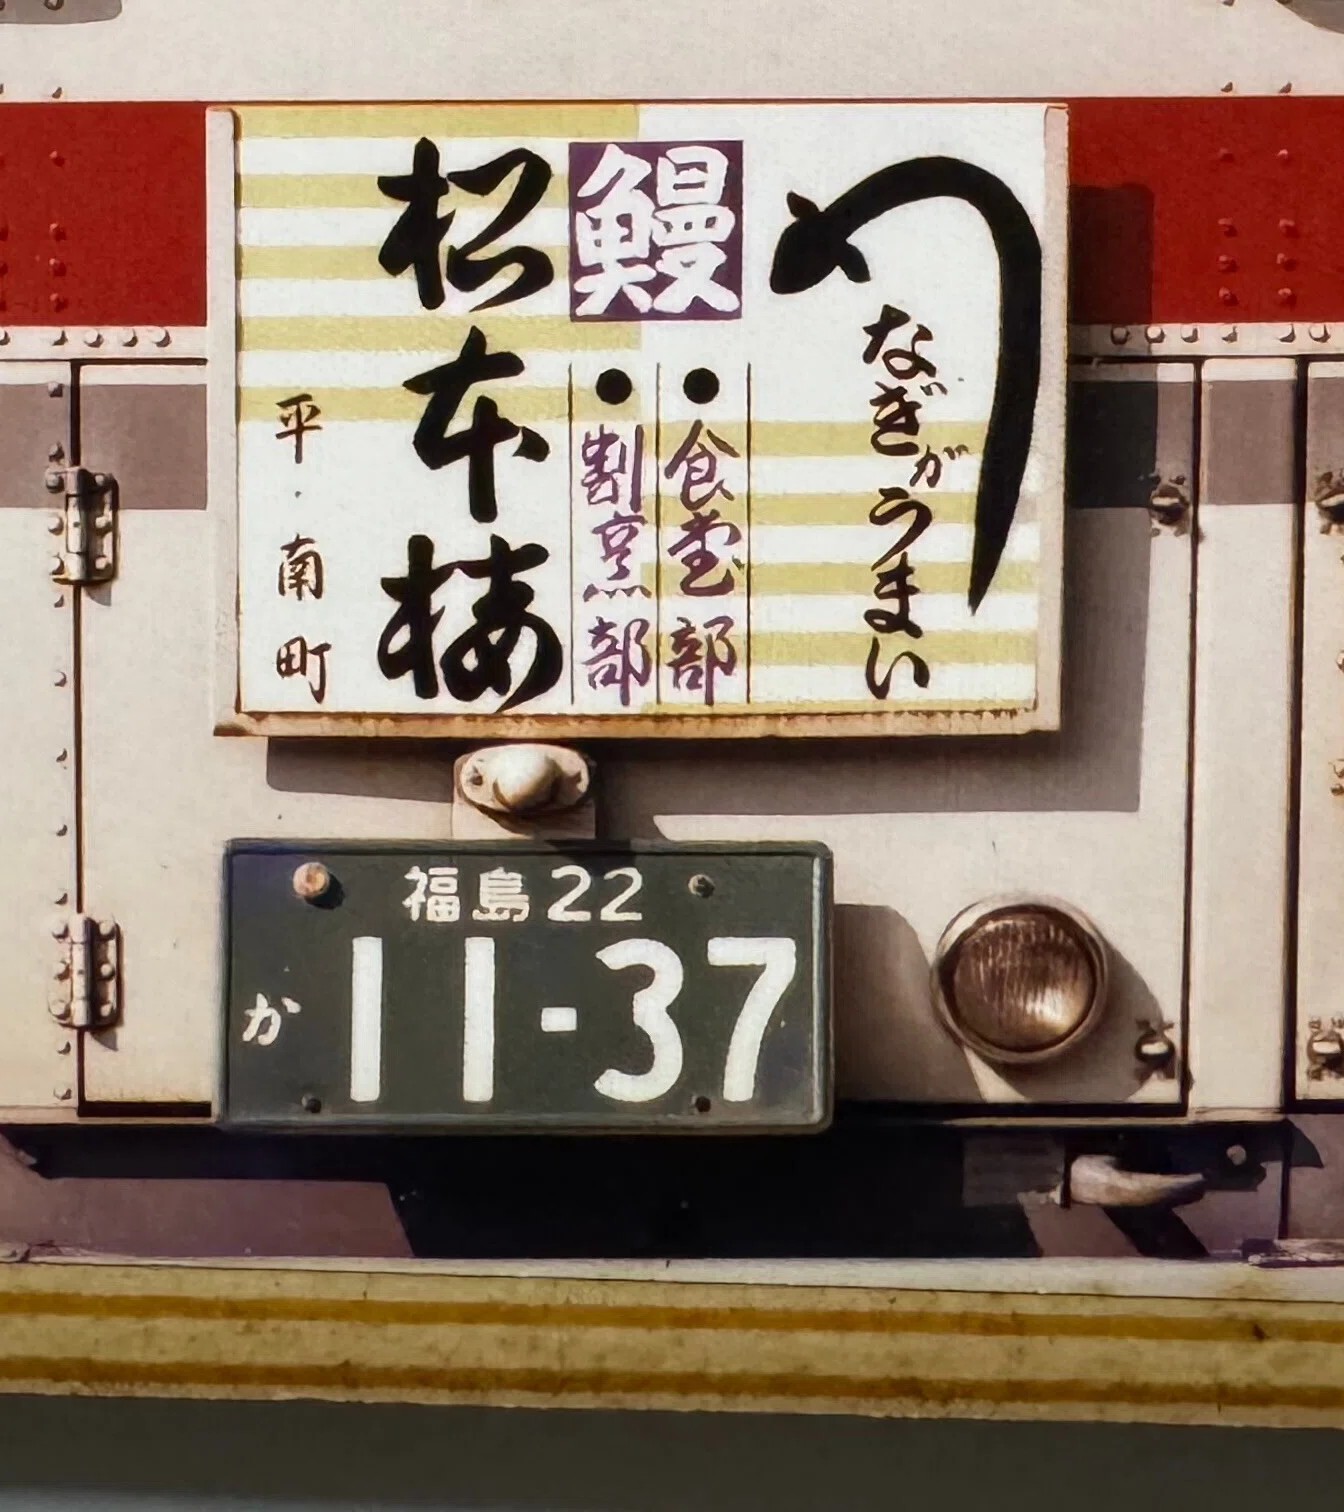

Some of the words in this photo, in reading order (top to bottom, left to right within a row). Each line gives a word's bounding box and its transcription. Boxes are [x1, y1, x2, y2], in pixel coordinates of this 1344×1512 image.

[575, 144, 742, 317] 鰻
[582, 423, 653, 707] 割烹部
[664, 420, 743, 707] 食堂部
[242, 993, 302, 1046] か
[350, 935, 797, 1102] 11-37
